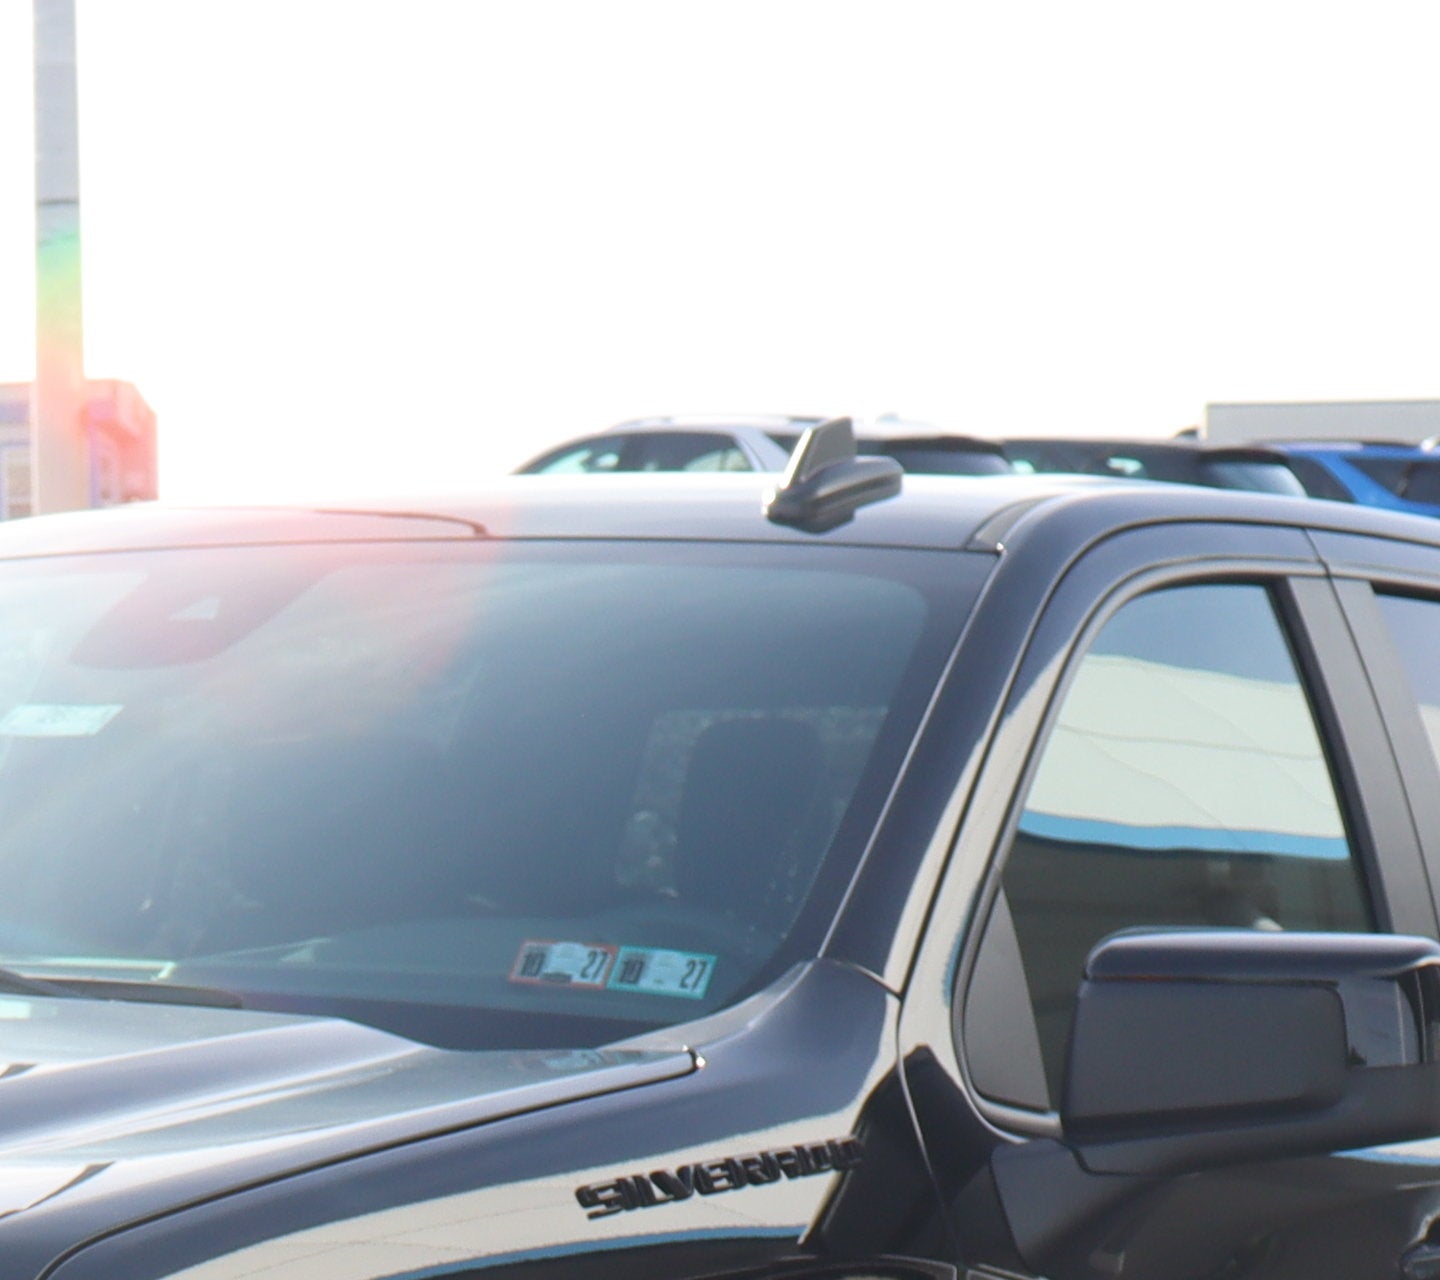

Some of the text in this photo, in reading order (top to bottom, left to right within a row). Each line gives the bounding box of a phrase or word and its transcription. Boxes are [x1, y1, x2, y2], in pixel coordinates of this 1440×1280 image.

[580, 949, 609, 981] 27
[679, 959, 708, 991] 27
[574, 1134, 864, 1220] SILVERADO
